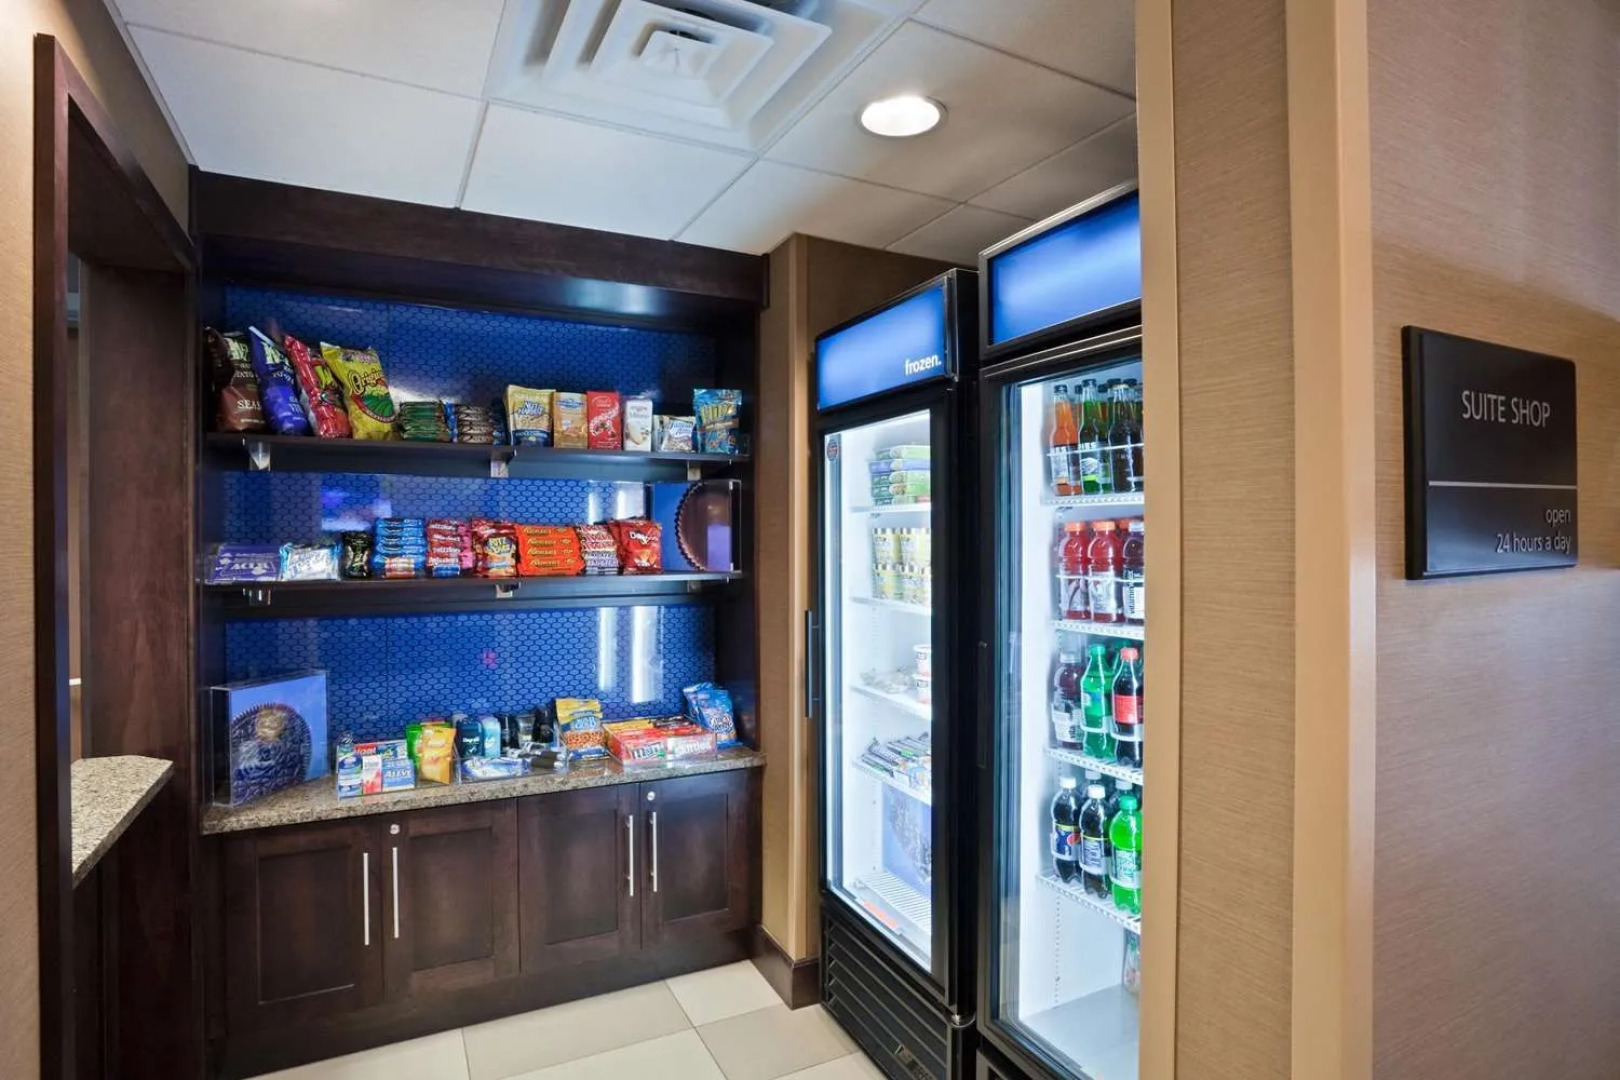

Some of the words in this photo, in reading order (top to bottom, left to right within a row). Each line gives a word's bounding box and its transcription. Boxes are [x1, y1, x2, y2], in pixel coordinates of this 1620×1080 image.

[904, 354, 942, 376] frozen.
[1461, 389, 1507, 423] SUITE
[1511, 397, 1550, 428] SHOP
[1545, 508, 1571, 526] open
[1496, 532, 1511, 554] 24
[1513, 531, 1543, 552] hours
[1545, 536, 1551, 550] a
[1553, 530, 1572, 555] day
